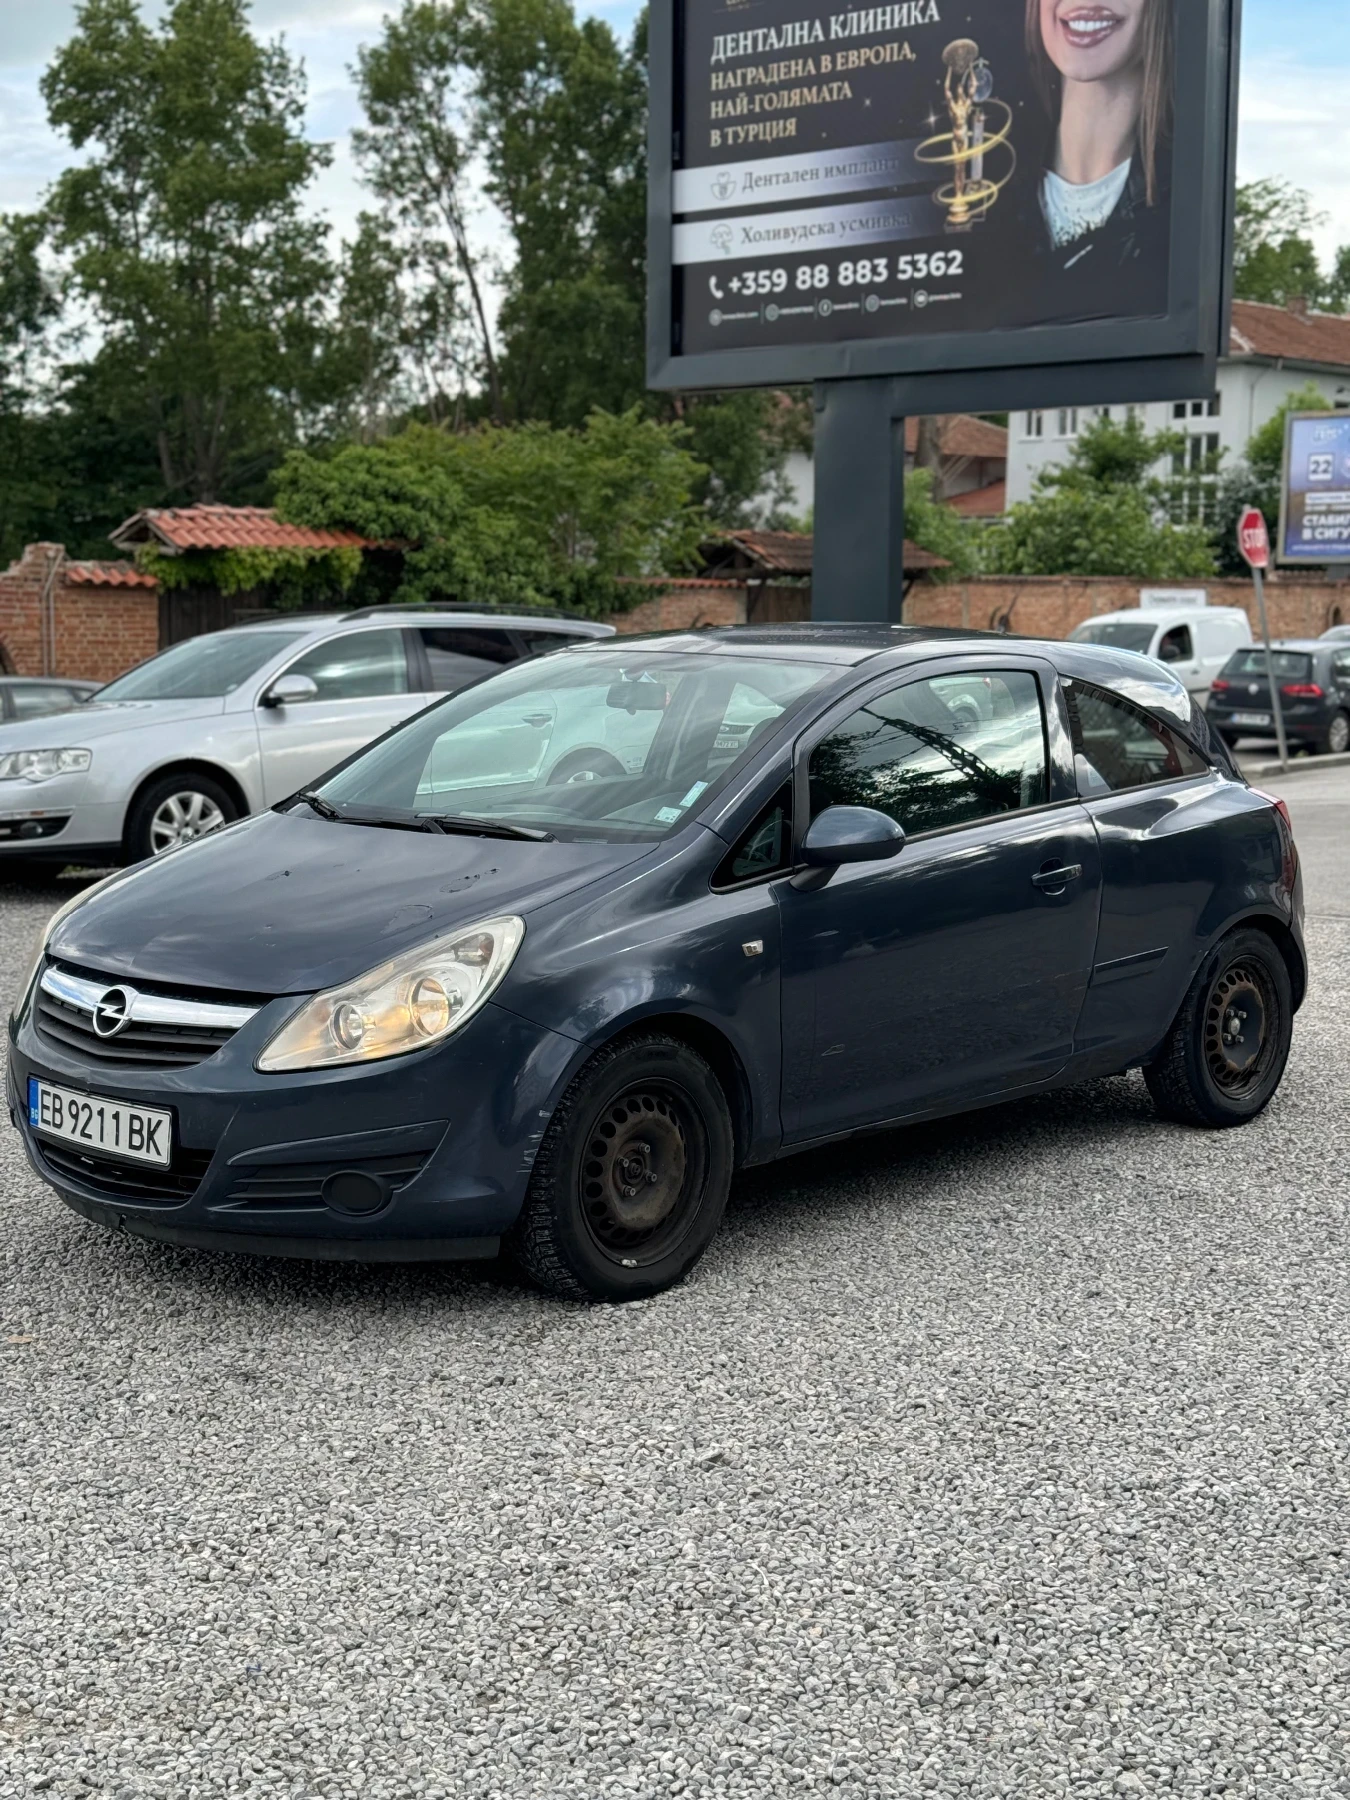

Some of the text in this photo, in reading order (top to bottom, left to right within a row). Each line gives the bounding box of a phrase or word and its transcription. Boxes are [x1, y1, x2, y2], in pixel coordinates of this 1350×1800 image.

[710, 0, 941, 65] ДЕНТАЛНА КЛИНИКА
[710, 41, 917, 91] НАГРАДЕНА В ЕВРОПА,
[710, 81, 852, 120] НАЙ-ГОЛЯМАТА
[710, 117, 797, 147] В ТУРЦИЯ
[742, 168, 820, 193] Дентален
[740, 213, 912, 248] Холивудска усмивка
[728, 250, 964, 296] +359 88 883 5362
[1311, 460, 1331, 475] 22
[1243, 528, 1266, 549] STOP
[40, 1089, 163, 1157] EB 9211 BK
